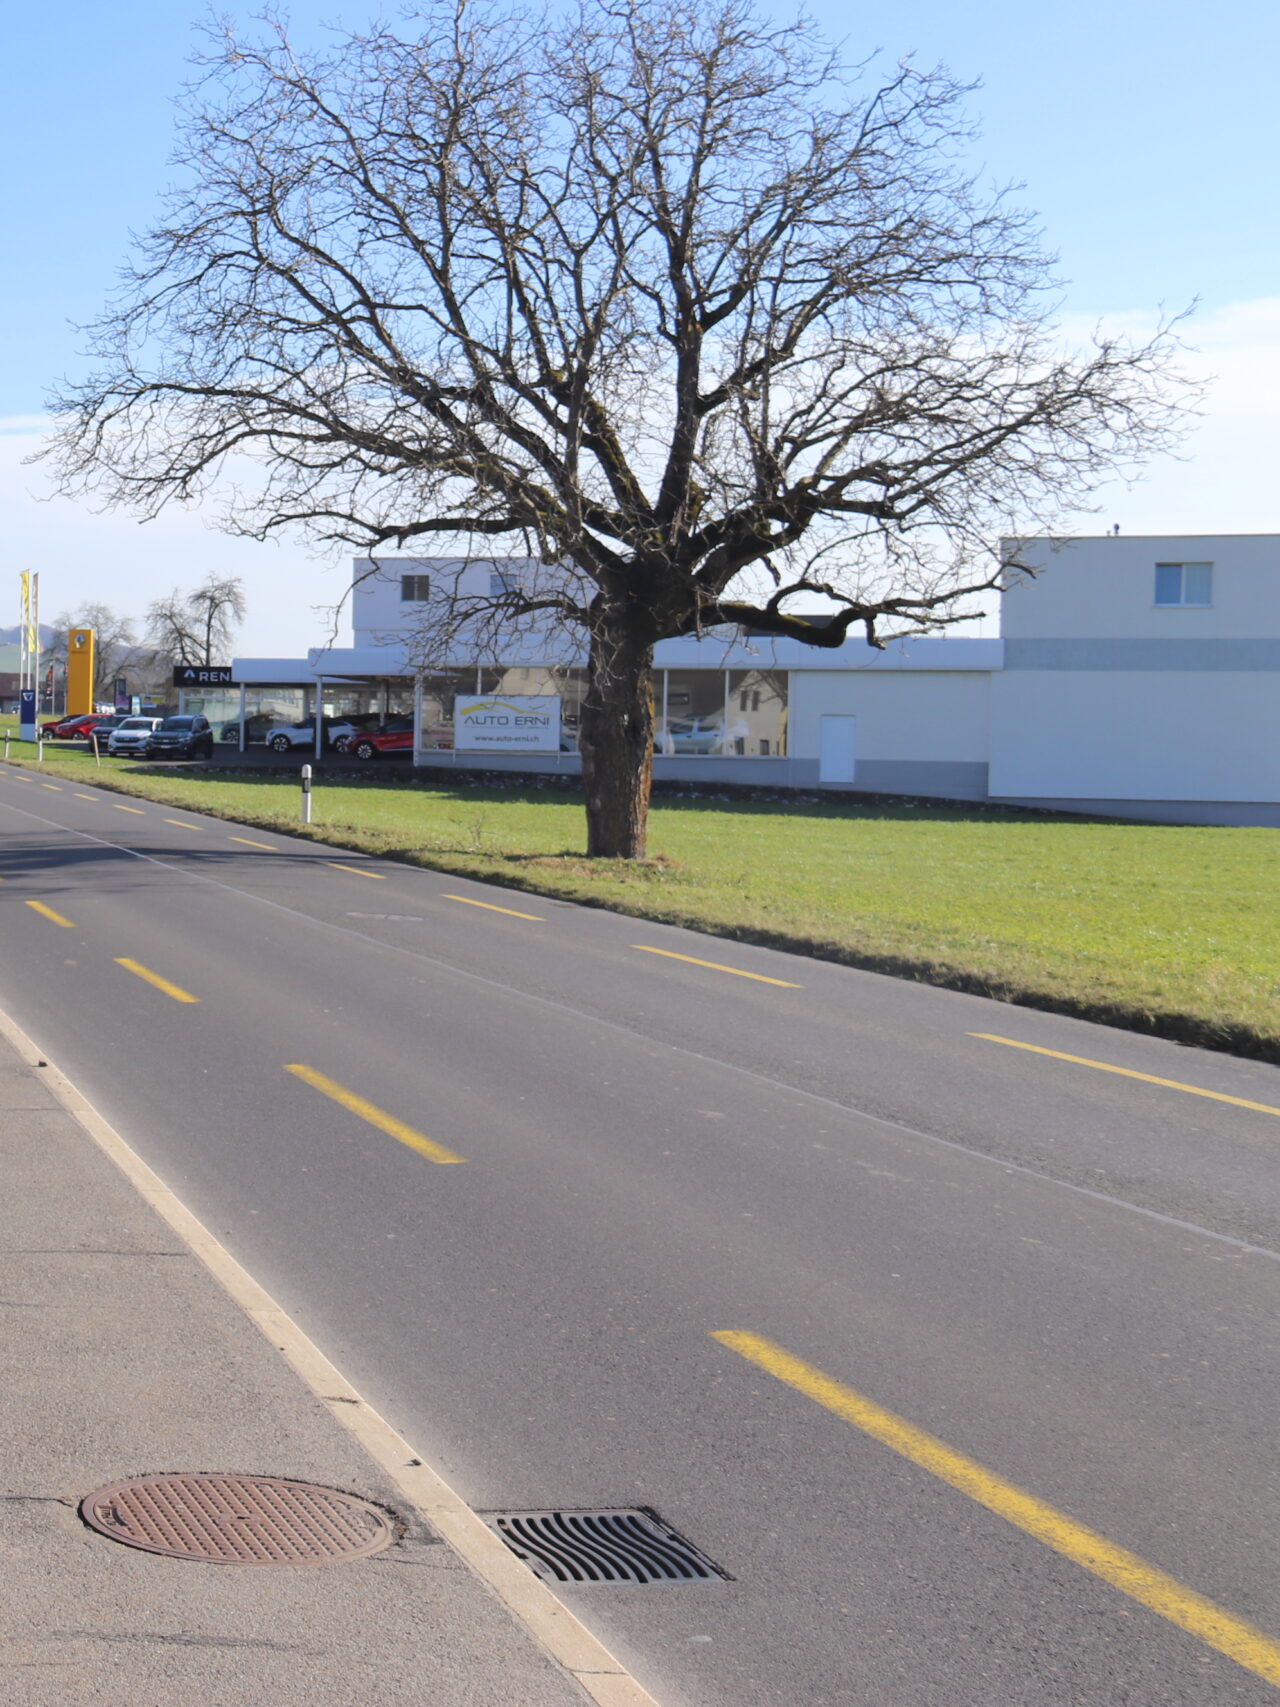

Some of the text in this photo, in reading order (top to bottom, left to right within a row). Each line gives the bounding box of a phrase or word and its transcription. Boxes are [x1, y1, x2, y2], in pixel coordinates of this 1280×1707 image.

[464, 715, 550, 726] AUTO ERNI
[474, 735, 540, 743] www.auto-erni.ch
